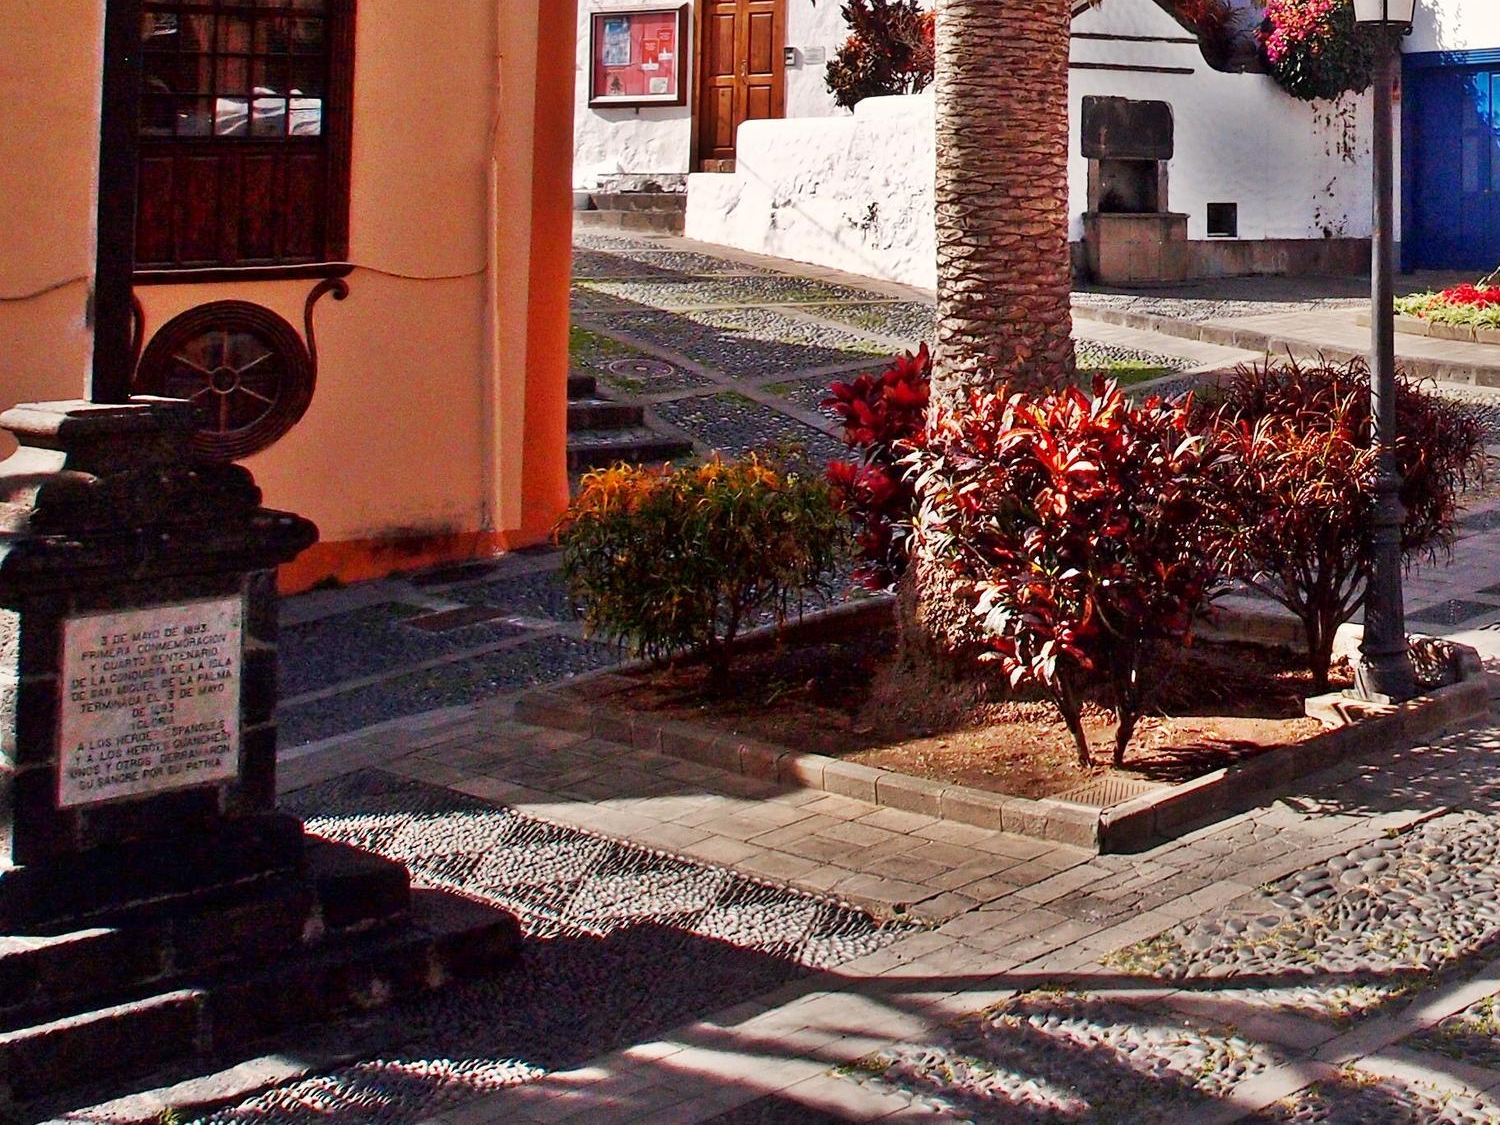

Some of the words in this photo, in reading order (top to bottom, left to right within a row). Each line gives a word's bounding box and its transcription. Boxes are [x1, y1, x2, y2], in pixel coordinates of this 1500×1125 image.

[113, 634, 127, 645] DE
[132, 630, 160, 642] MAYO
[164, 627, 178, 637] DE
[82, 646, 130, 660] PRIMERA
[103, 657, 146, 671] CUARTO
[71, 678, 86, 689] DE
[91, 675, 105, 686] LA
[110, 667, 166, 683] CONQUISTA
[171, 663, 184, 674] DE
[190, 661, 204, 671] LA
[209, 656, 232, 668] ISLA
[71, 691, 86, 702] DE
[91, 687, 112, 699] SAN
[117, 680, 156, 695] MIGUEL
[161, 677, 174, 688] DE
[179, 675, 192, 685] LA
[197, 669, 232, 683] PALMA
[80, 695, 140, 714] TERMINADA
[147, 692, 160, 703] EL
[180, 687, 193, 698] DE
[198, 682, 224, 696] MAYO
[133, 707, 145, 718] DE
[90, 737, 111, 750] LOS
[100, 749, 122, 761] LOS
[116, 756, 151, 771] OTROS
[79, 779, 93, 790] SU
[98, 771, 138, 787] SANGRE
[143, 767, 163, 779] POR
[168, 764, 180, 775] SU
[186, 757, 221, 772] PATRIA
